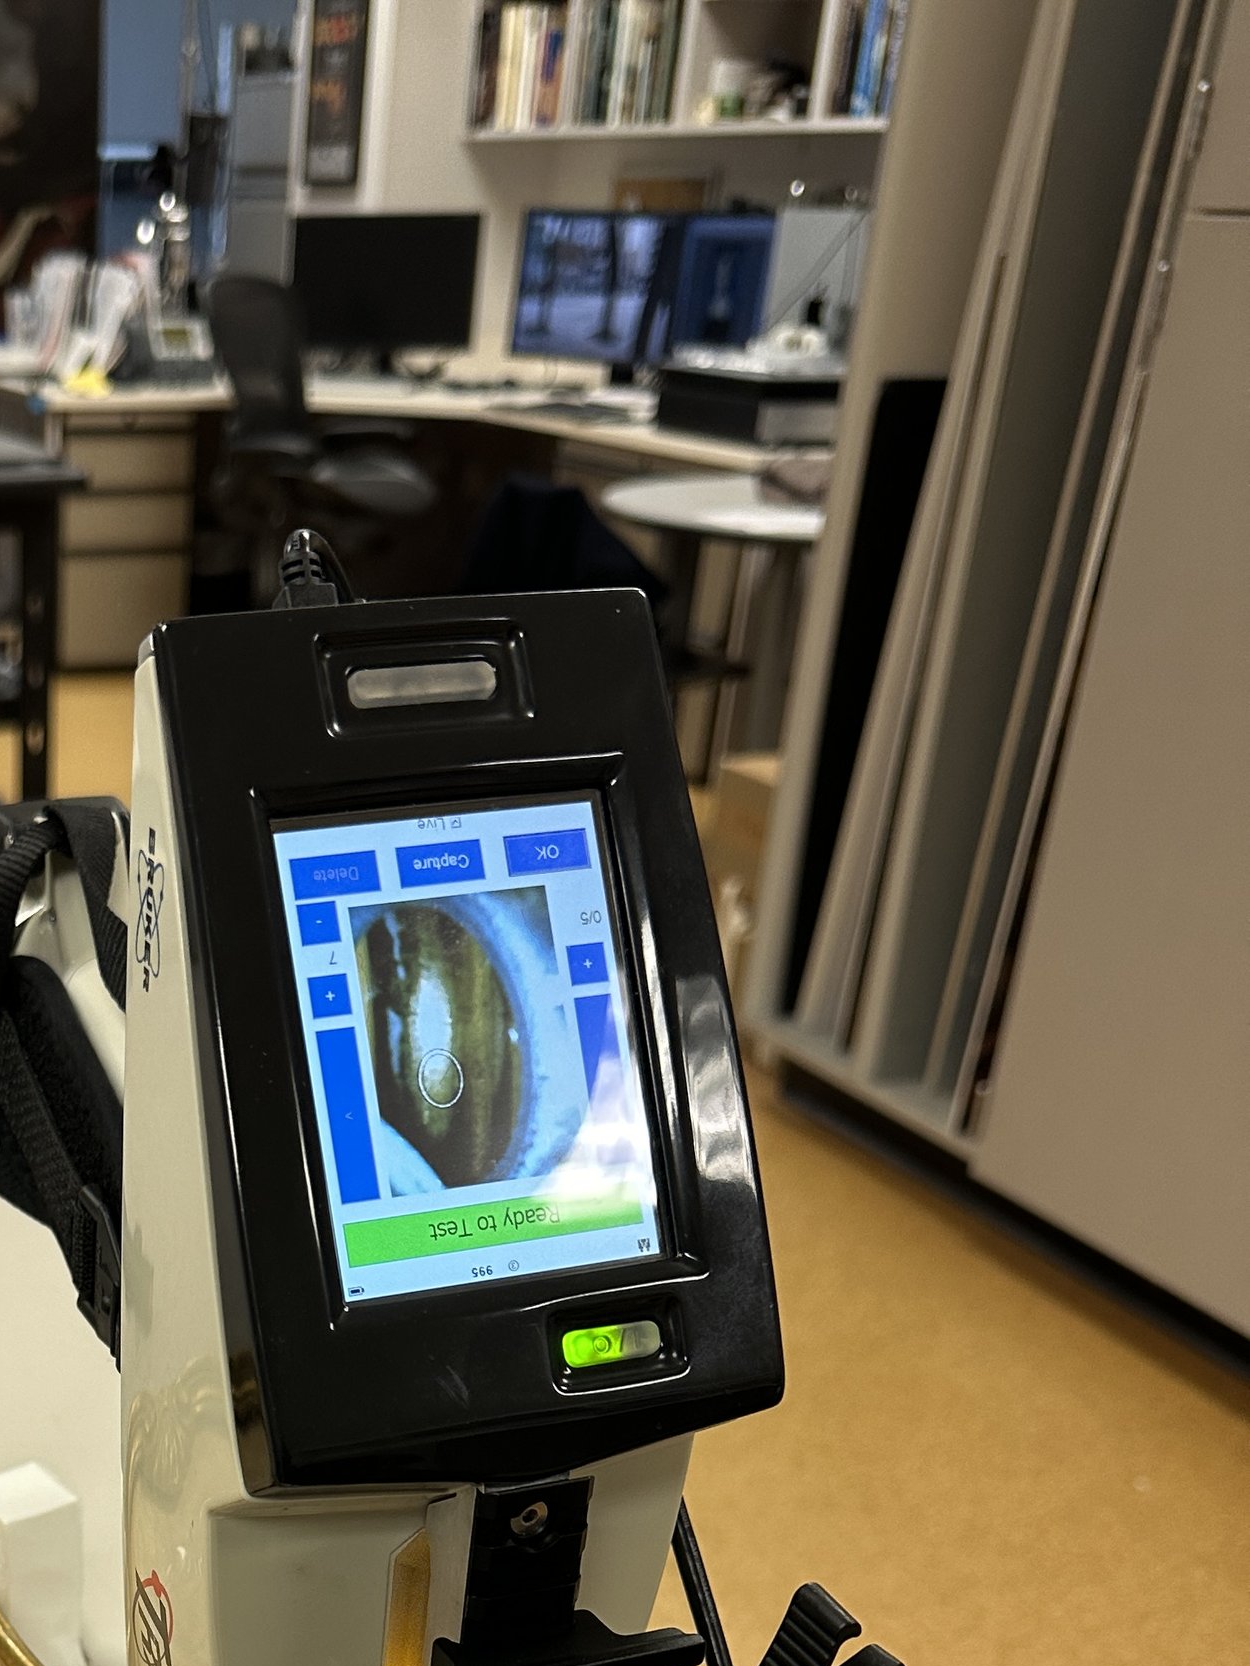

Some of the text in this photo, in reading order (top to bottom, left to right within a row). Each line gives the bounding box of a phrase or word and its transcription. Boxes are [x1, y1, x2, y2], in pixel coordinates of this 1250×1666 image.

[417, 817, 446, 831] Live
[534, 844, 560, 861] OK
[413, 853, 470, 871] Capture
[313, 866, 360, 882] Delete
[580, 910, 602, 925] 0/5
[329, 950, 338, 965] 7
[428, 1206, 561, 1241] Ready to Test
[471, 1265, 494, 1278] 995
